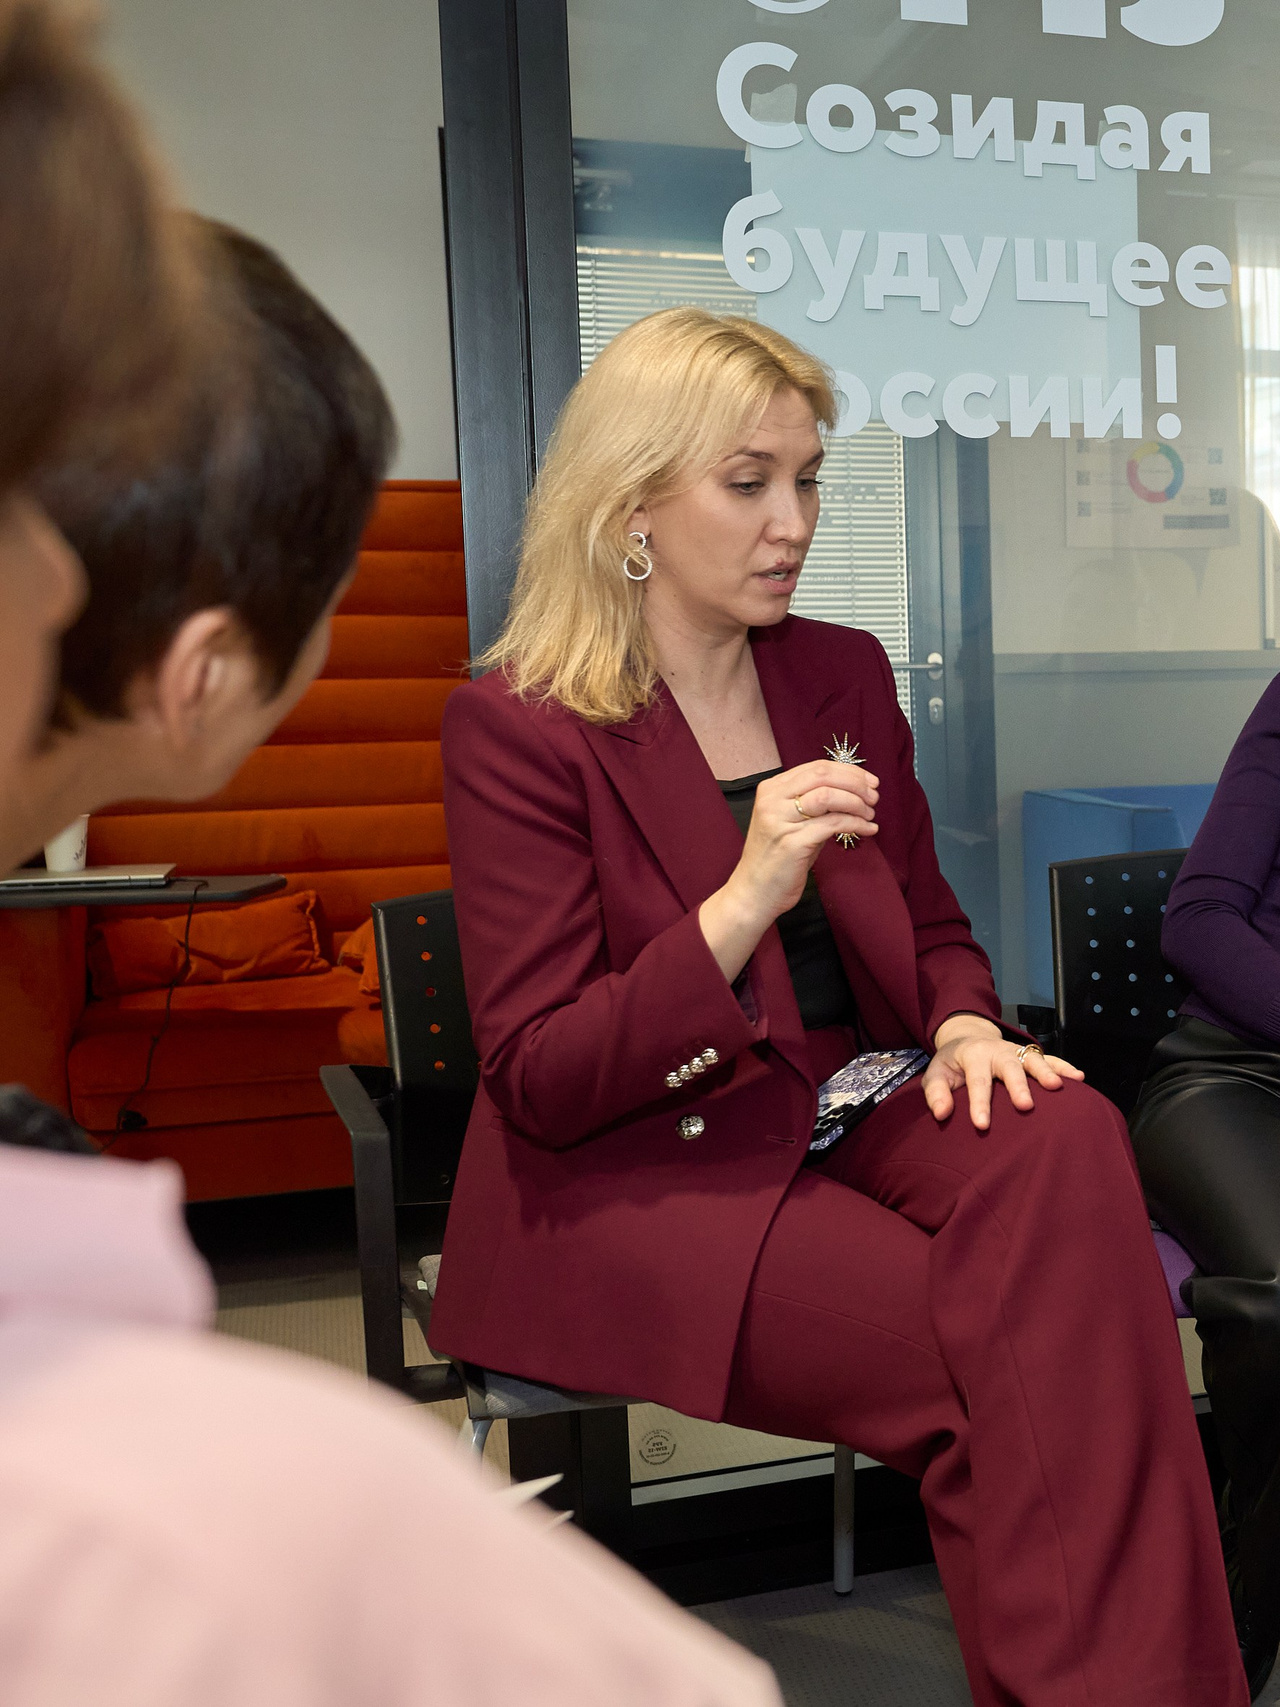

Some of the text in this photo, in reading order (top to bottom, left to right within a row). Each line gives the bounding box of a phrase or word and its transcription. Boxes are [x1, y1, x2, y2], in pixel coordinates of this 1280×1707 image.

[716, 41, 1211, 180] Созидая
[722, 190, 1232, 327] будущее
[826, 345, 1183, 439] оссии!
